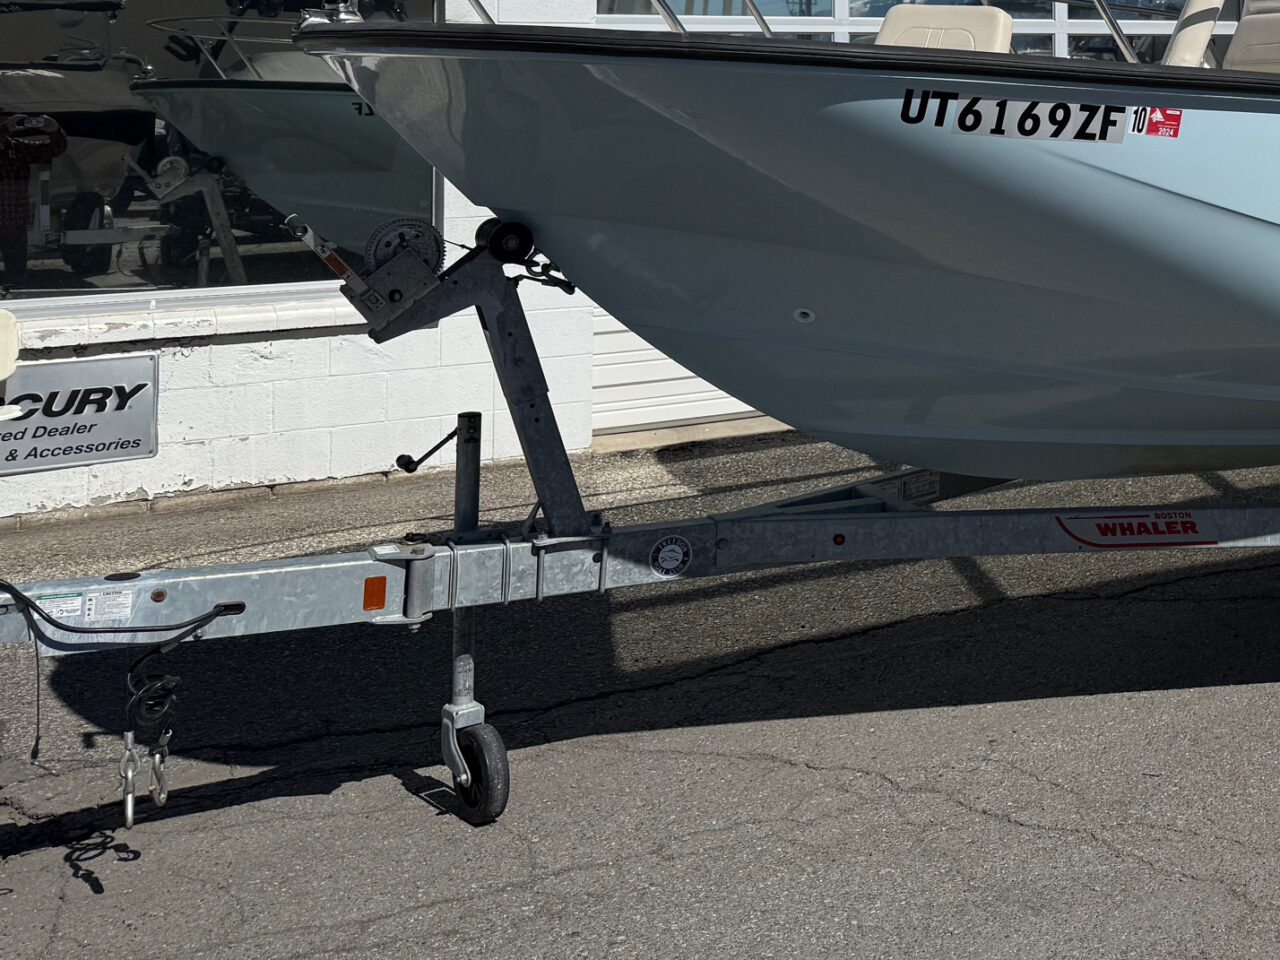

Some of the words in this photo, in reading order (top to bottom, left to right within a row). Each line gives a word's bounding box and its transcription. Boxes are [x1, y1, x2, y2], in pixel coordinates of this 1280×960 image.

[900, 88, 1126, 141] UT6169ZF
[1132, 106, 1147, 134] 10
[1158, 127, 1174, 136] 2024
[0, 383, 150, 421] CURY
[0, 428, 28, 442] ed
[32, 422, 97, 439] Dealer
[5, 448, 19, 462] &
[24, 437, 142, 460] Accessories
[1154, 511, 1192, 520] BOSTON
[1095, 520, 1200, 537] WHALER
